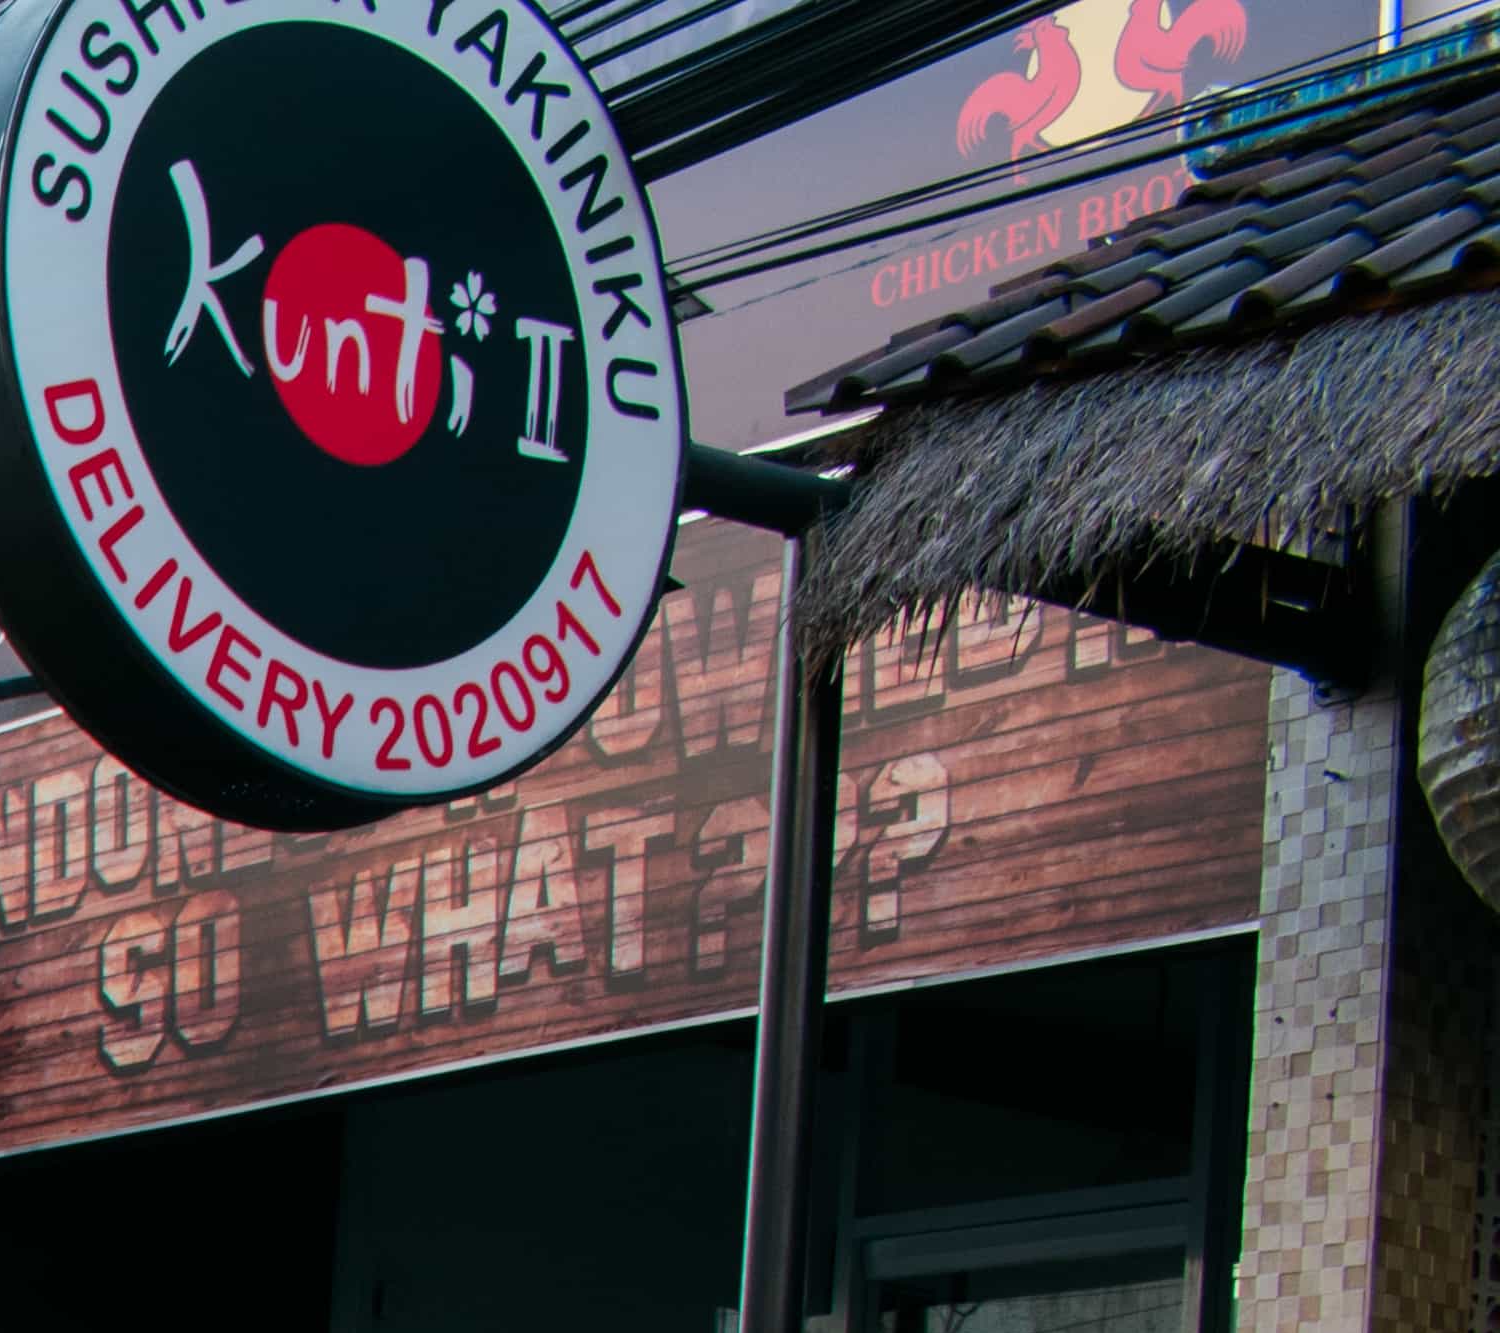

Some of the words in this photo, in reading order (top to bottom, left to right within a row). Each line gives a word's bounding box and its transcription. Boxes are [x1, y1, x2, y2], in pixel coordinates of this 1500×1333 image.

[871, 209, 1064, 309] CHICKEN
[43, 379, 351, 761] DELIVERY
[370, 551, 622, 771] 2020917
[102, 890, 241, 1070] SO
